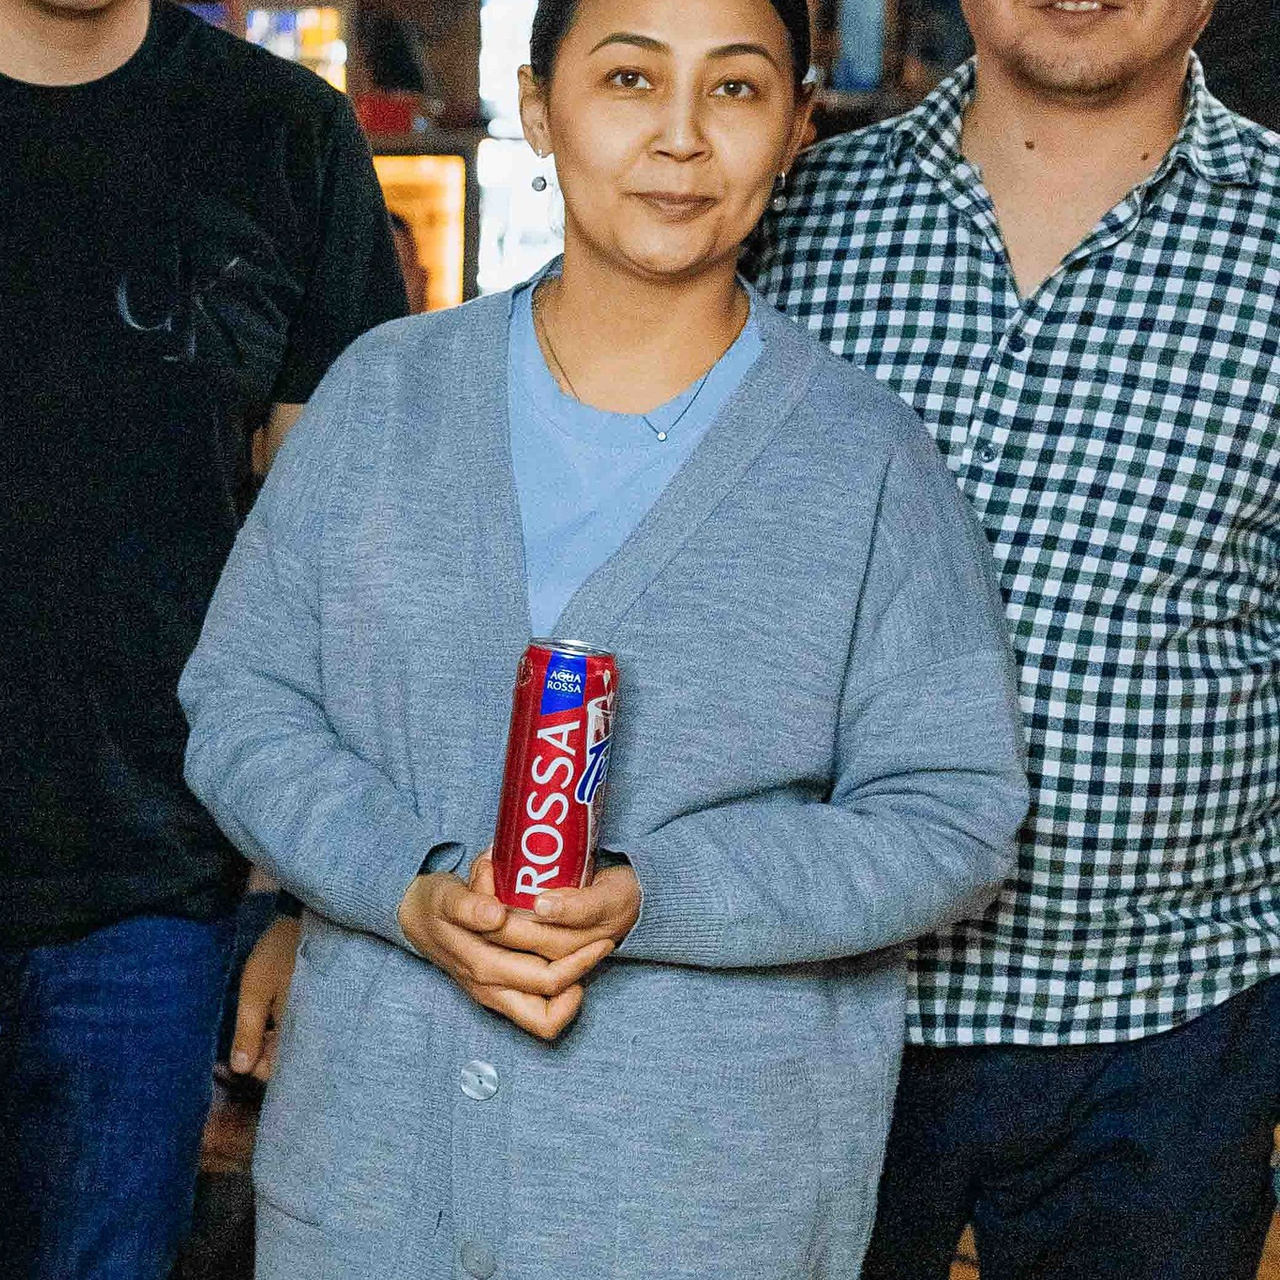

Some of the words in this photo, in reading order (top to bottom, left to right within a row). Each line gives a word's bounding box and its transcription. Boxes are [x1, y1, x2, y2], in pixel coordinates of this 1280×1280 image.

[550, 670, 582, 684] AQUA
[546, 680, 582, 694] ROSSA
[515, 720, 581, 896] ROSSA
